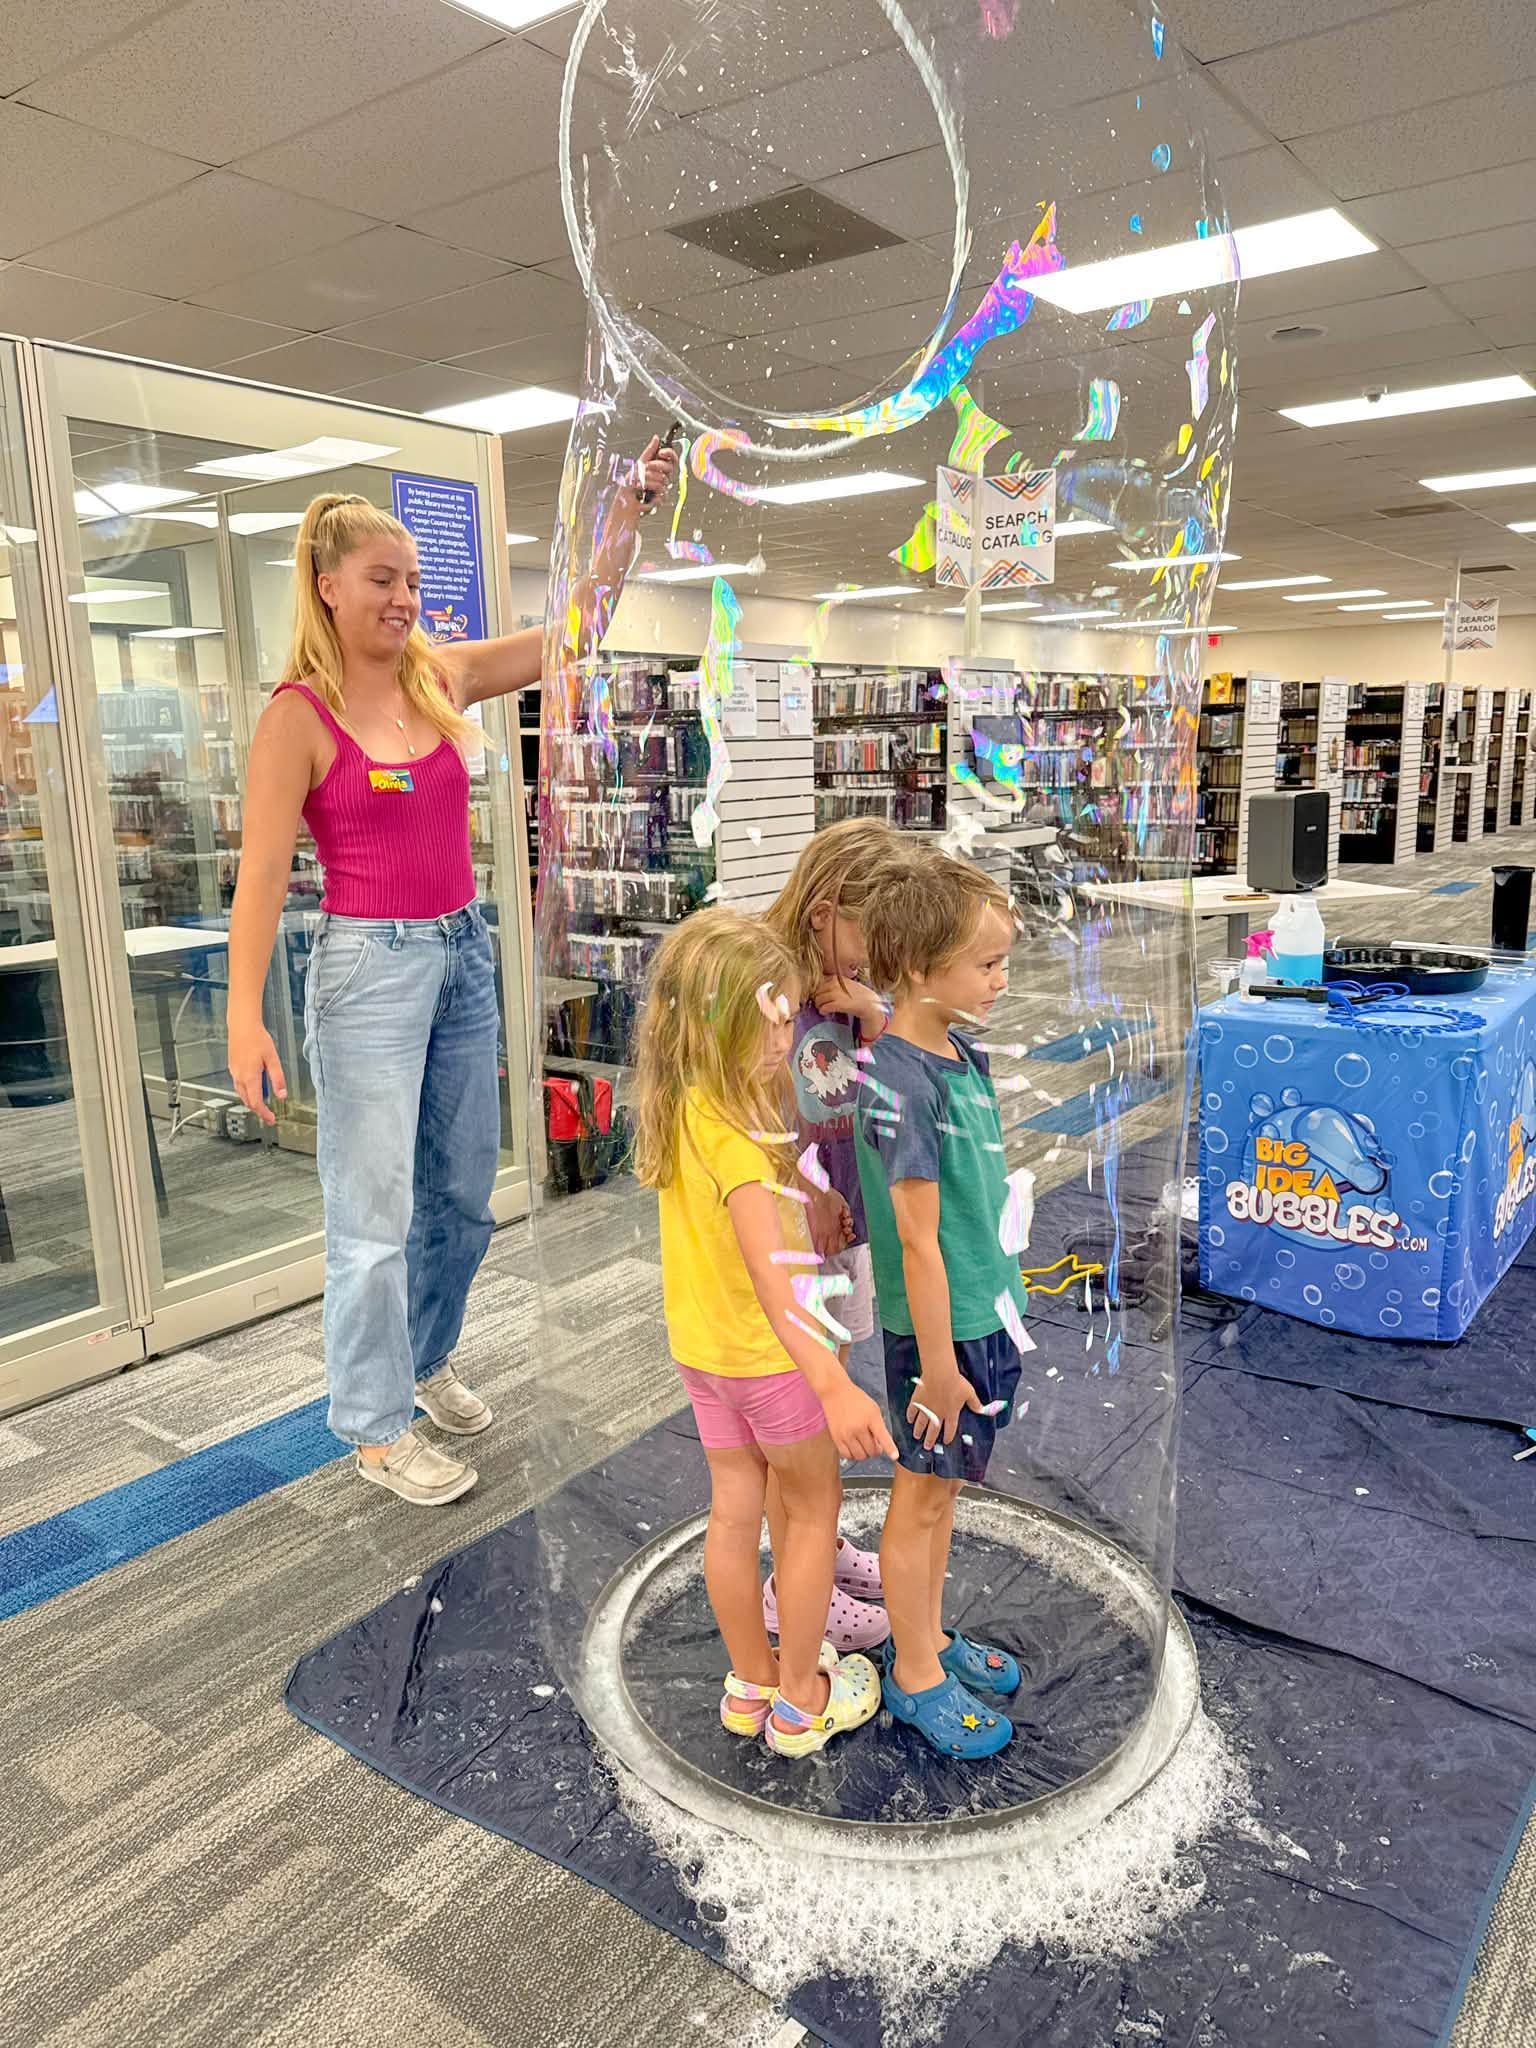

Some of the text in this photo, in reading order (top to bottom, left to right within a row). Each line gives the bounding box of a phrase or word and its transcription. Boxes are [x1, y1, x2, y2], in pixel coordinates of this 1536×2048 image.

[415, 488, 431, 498] being
[431, 492, 449, 500] present
[456, 494, 465, 502] this
[425, 499, 441, 509] library
[457, 505, 467, 513] you
[411, 516, 466, 531] Orange County Library
[985, 509, 1048, 530] SEARCH
[938, 528, 972, 550] CATALOG
[981, 530, 1053, 550] CATALOG
[1457, 624, 1496, 633] CATALOG
[1460, 615, 1495, 624] SEARCH
[1255, 1136, 1310, 1167] BIG
[1254, 1164, 1342, 1203] IDEA
[1225, 1180, 1401, 1249] BUBBLES
